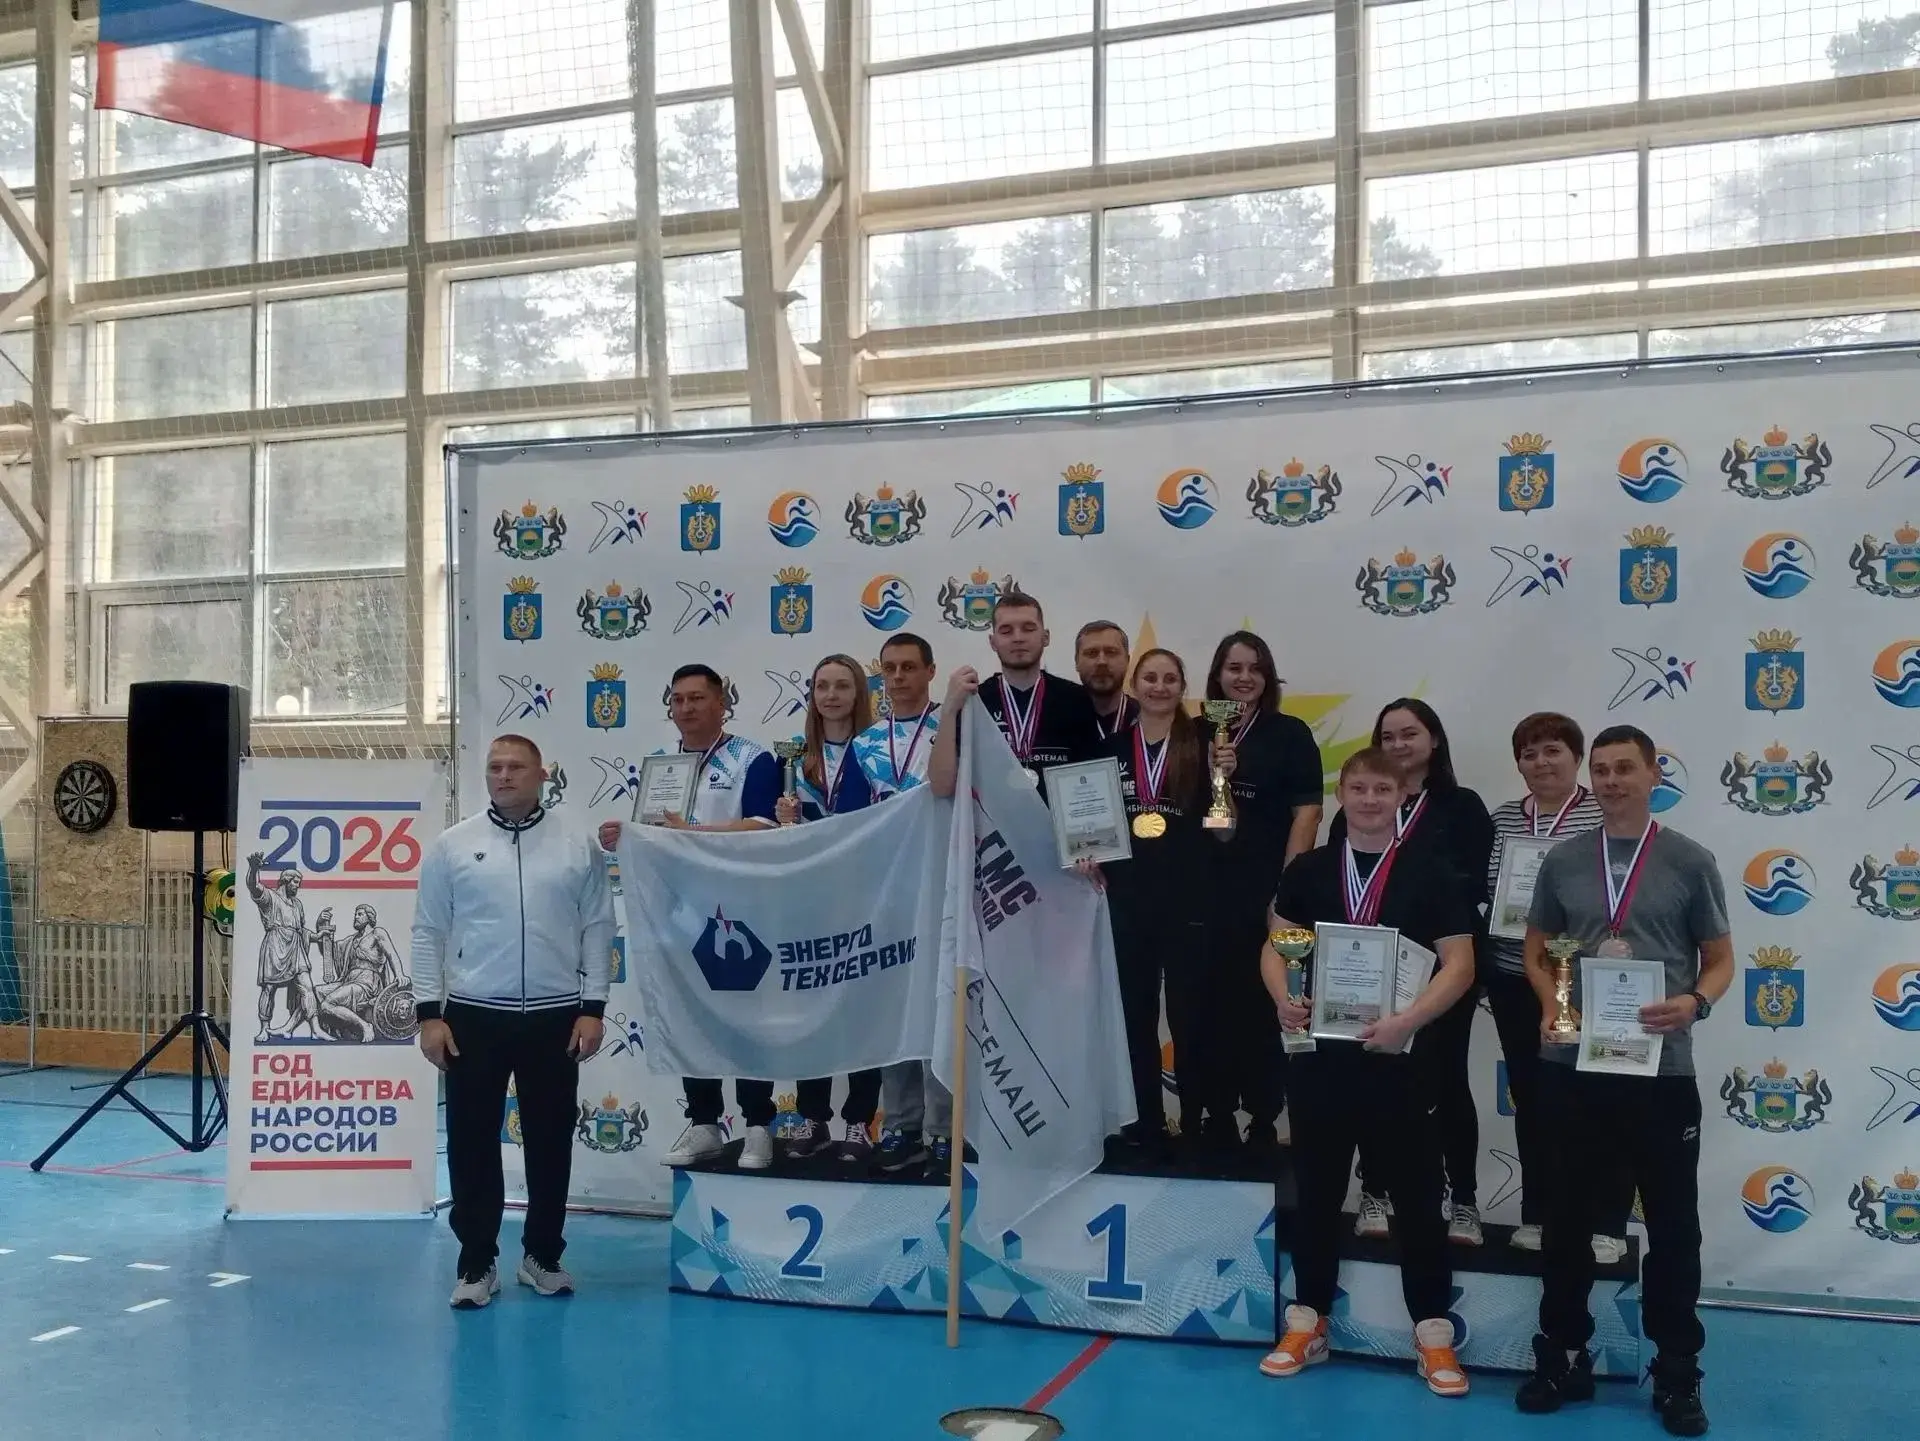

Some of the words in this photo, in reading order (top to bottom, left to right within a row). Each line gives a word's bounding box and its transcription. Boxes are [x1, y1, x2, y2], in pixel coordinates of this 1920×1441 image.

[1122, 780, 1136, 790] МС
[1126, 803, 1184, 816] ИБНЕФТЕМАШ
[259, 815, 422, 873] 2026
[777, 923, 873, 964] ЭНЕРГО
[252, 1054, 313, 1078] ГОД
[252, 1079, 414, 1104] ЕДИНСТВА
[251, 1106, 398, 1129] НАРОДОВ
[250, 1132, 378, 1154] РОССИИ
[782, 1203, 825, 1279] 2
[1086, 1203, 1144, 1302] 1
